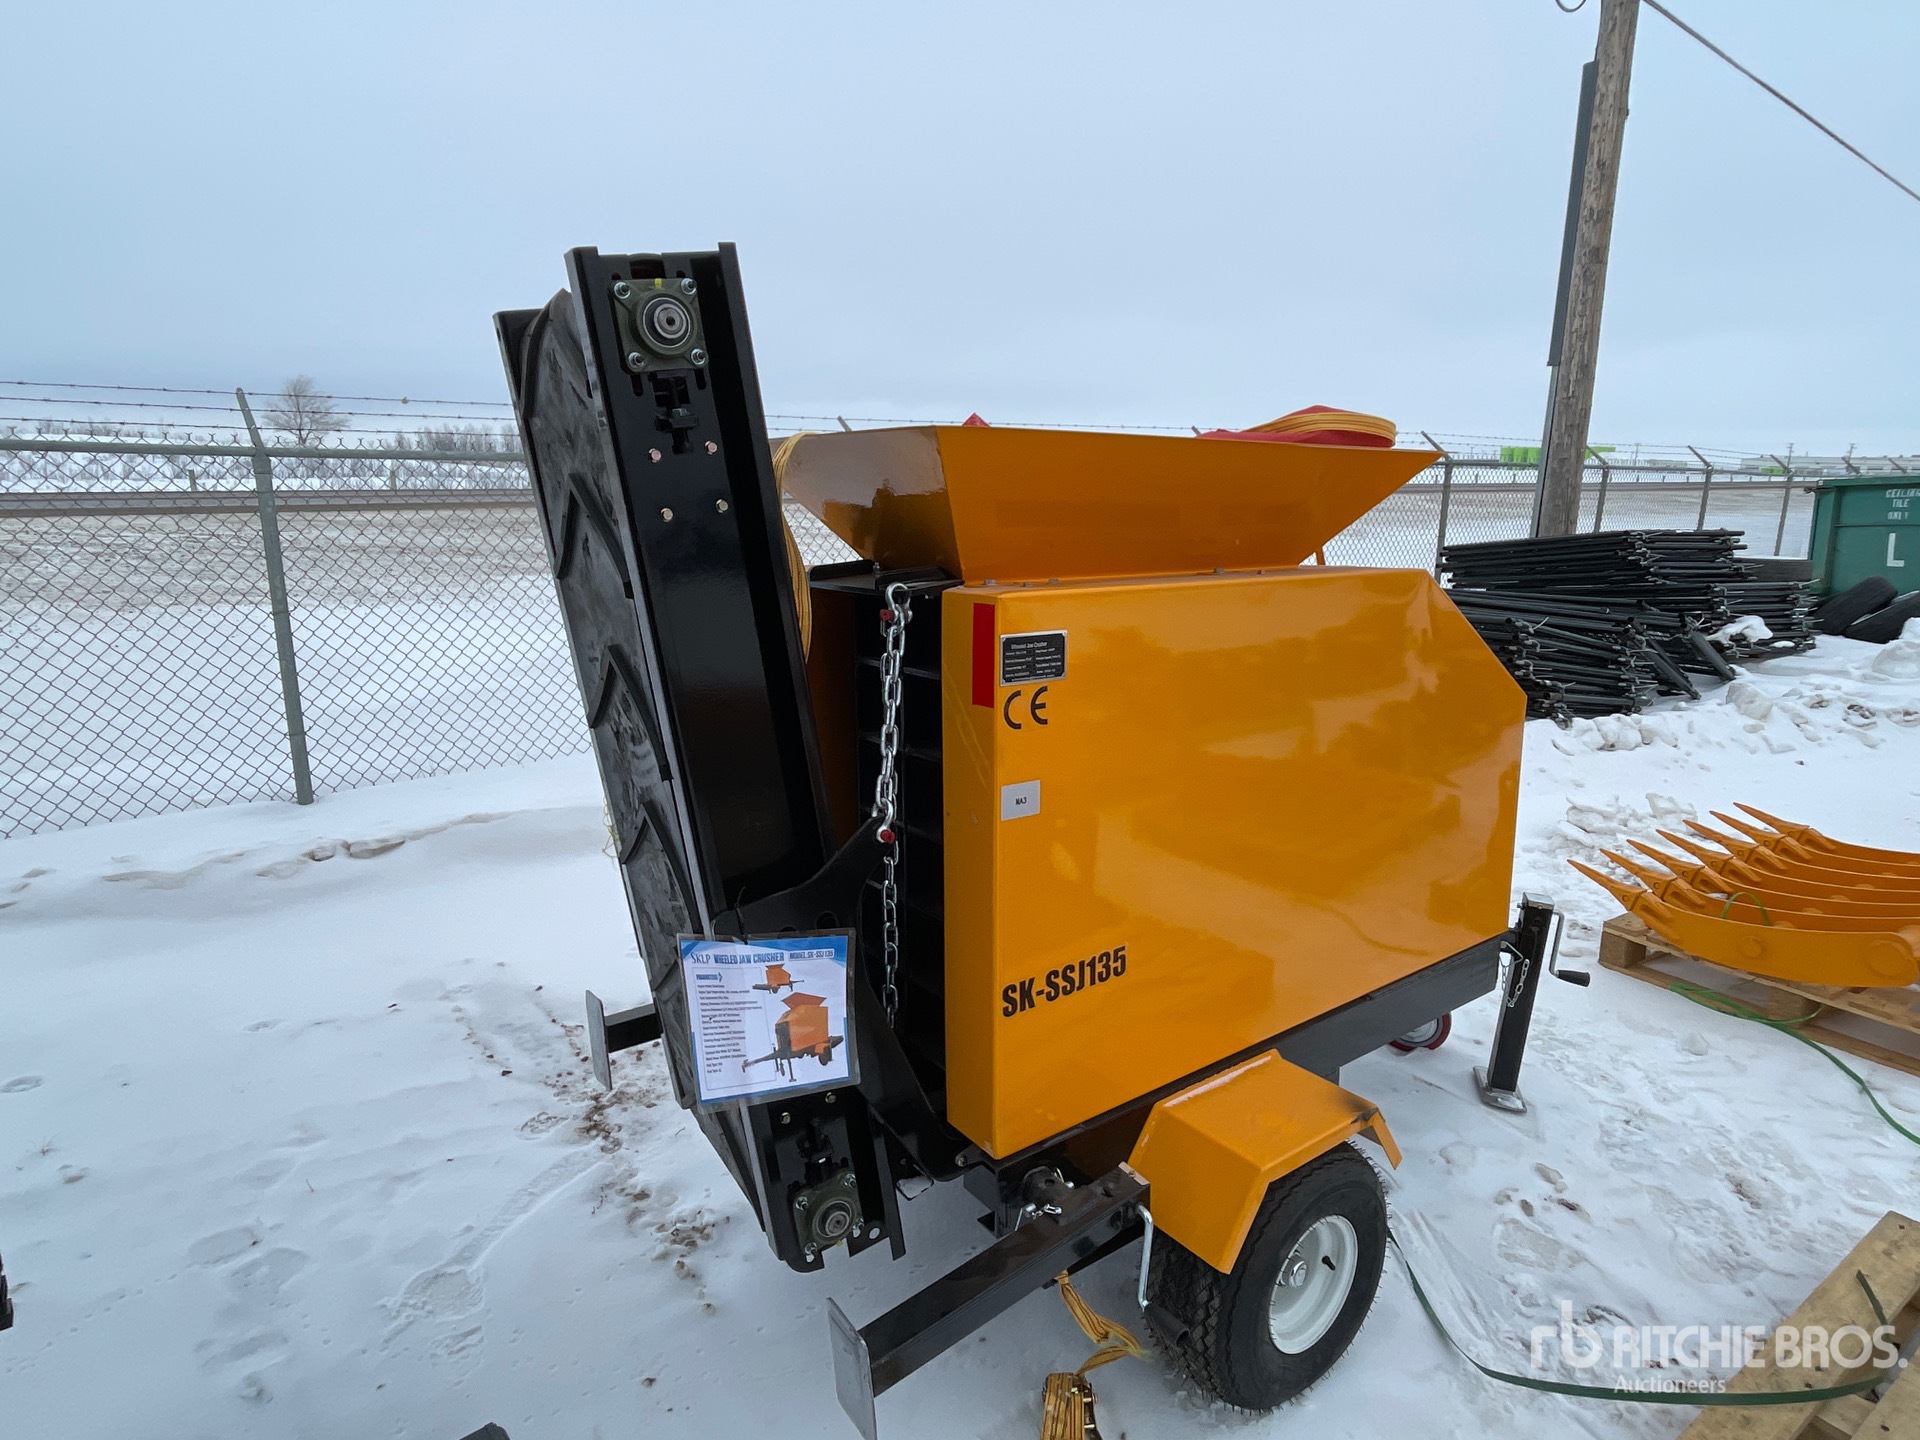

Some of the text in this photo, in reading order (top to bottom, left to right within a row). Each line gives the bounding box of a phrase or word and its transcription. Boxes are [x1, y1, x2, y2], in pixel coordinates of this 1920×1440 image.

[1892, 498, 1910, 508] TILE
[1886, 532, 1905, 568] L
[1003, 685, 1048, 730] CE
[713, 954, 738, 965] WHEELED
[738, 953, 752, 964] JAW
[753, 951, 785, 963] CRUSHER
[1002, 944, 1127, 1018] SK-SSJ135
